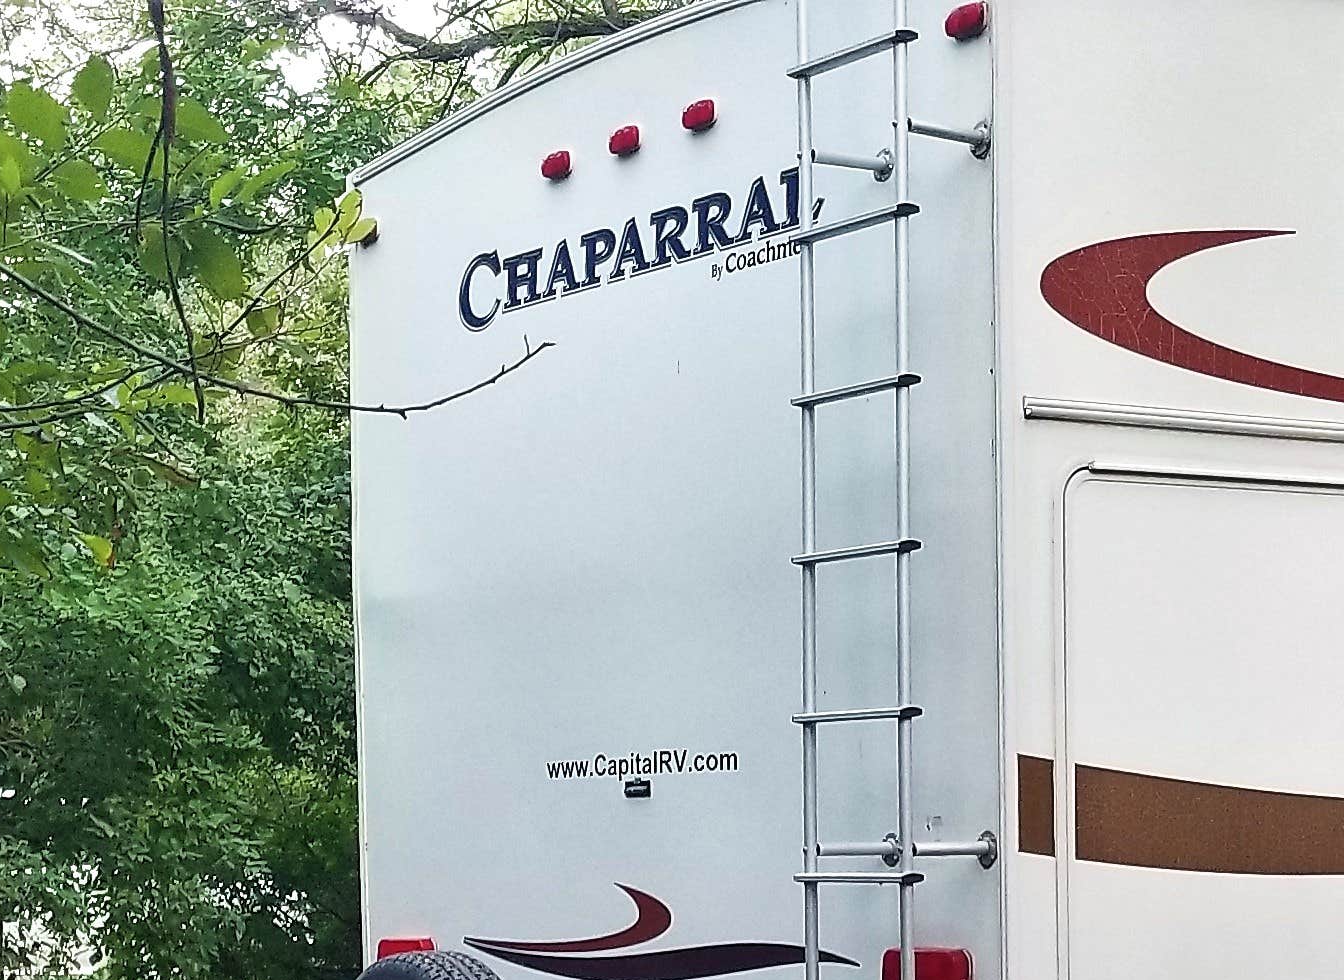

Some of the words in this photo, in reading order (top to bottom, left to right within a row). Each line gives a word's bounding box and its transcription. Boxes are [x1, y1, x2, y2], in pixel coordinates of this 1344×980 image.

[459, 166, 825, 332] CHAPARRAL
[711, 263, 723, 281] By
[725, 239, 802, 273] Coachm
[547, 749, 738, 781] www.CapitalRV.com
